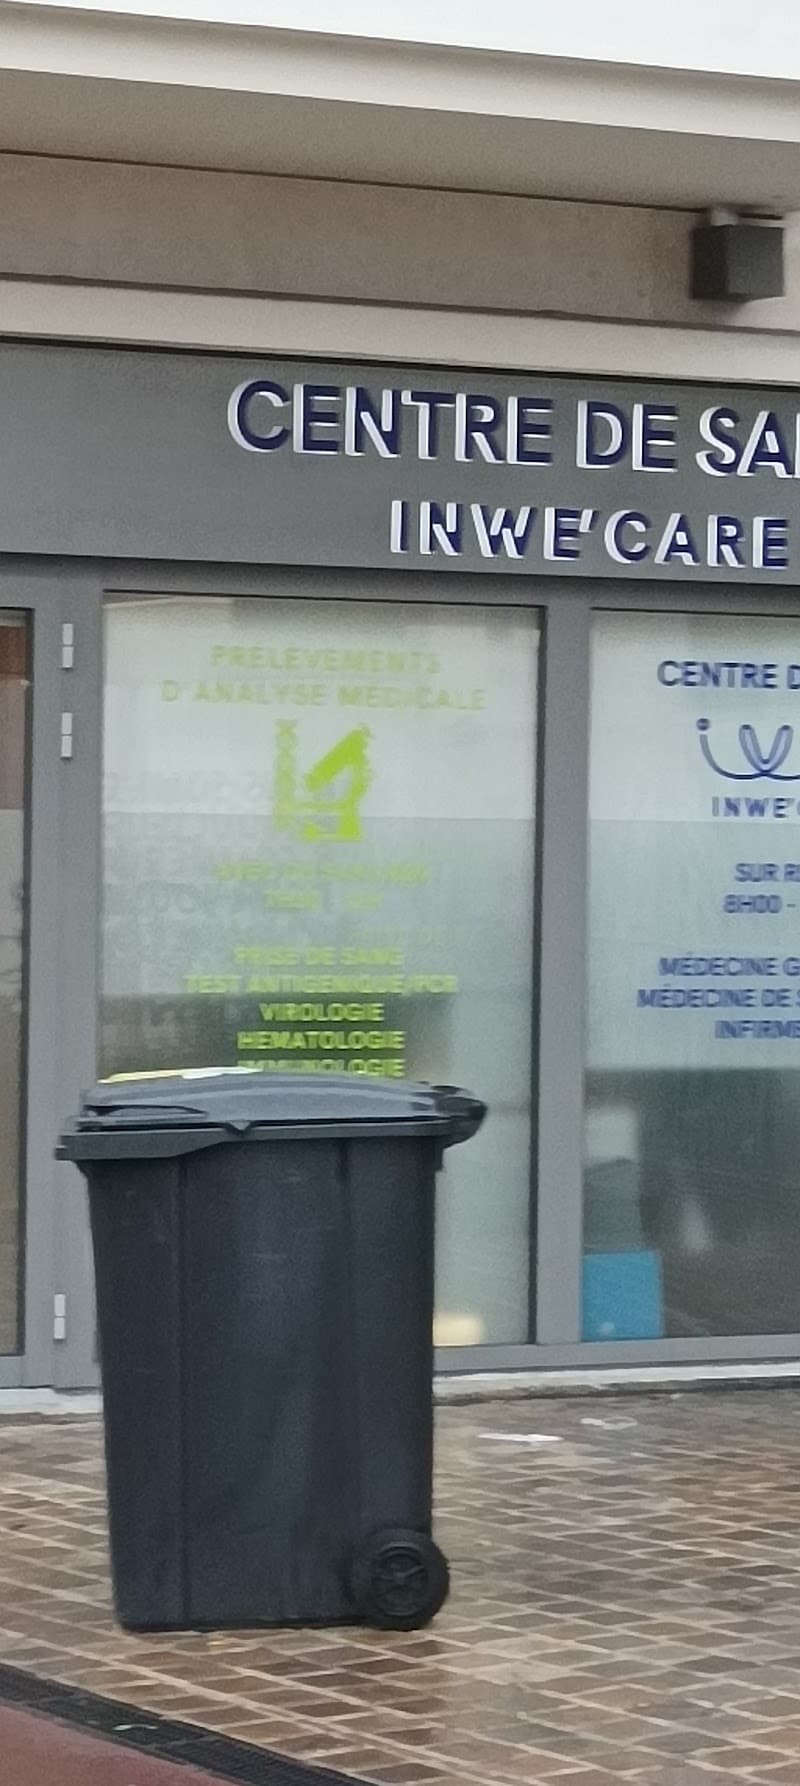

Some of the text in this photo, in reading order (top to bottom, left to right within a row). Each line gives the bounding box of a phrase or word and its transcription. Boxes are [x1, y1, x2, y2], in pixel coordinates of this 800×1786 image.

[228, 379, 800, 479] CENTRE DE SA
[390, 499, 790, 569] INWE'CARE
[657, 660, 778, 689] CENTRE
[233, 946, 298, 966] PRISE
[304, 947, 336, 966] DE
[183, 975, 240, 994] TEST
[761, 988, 792, 1008] DE
[258, 1002, 384, 1022] VIROLOGIE
[237, 1030, 406, 1050] HEMATOLOGIE
